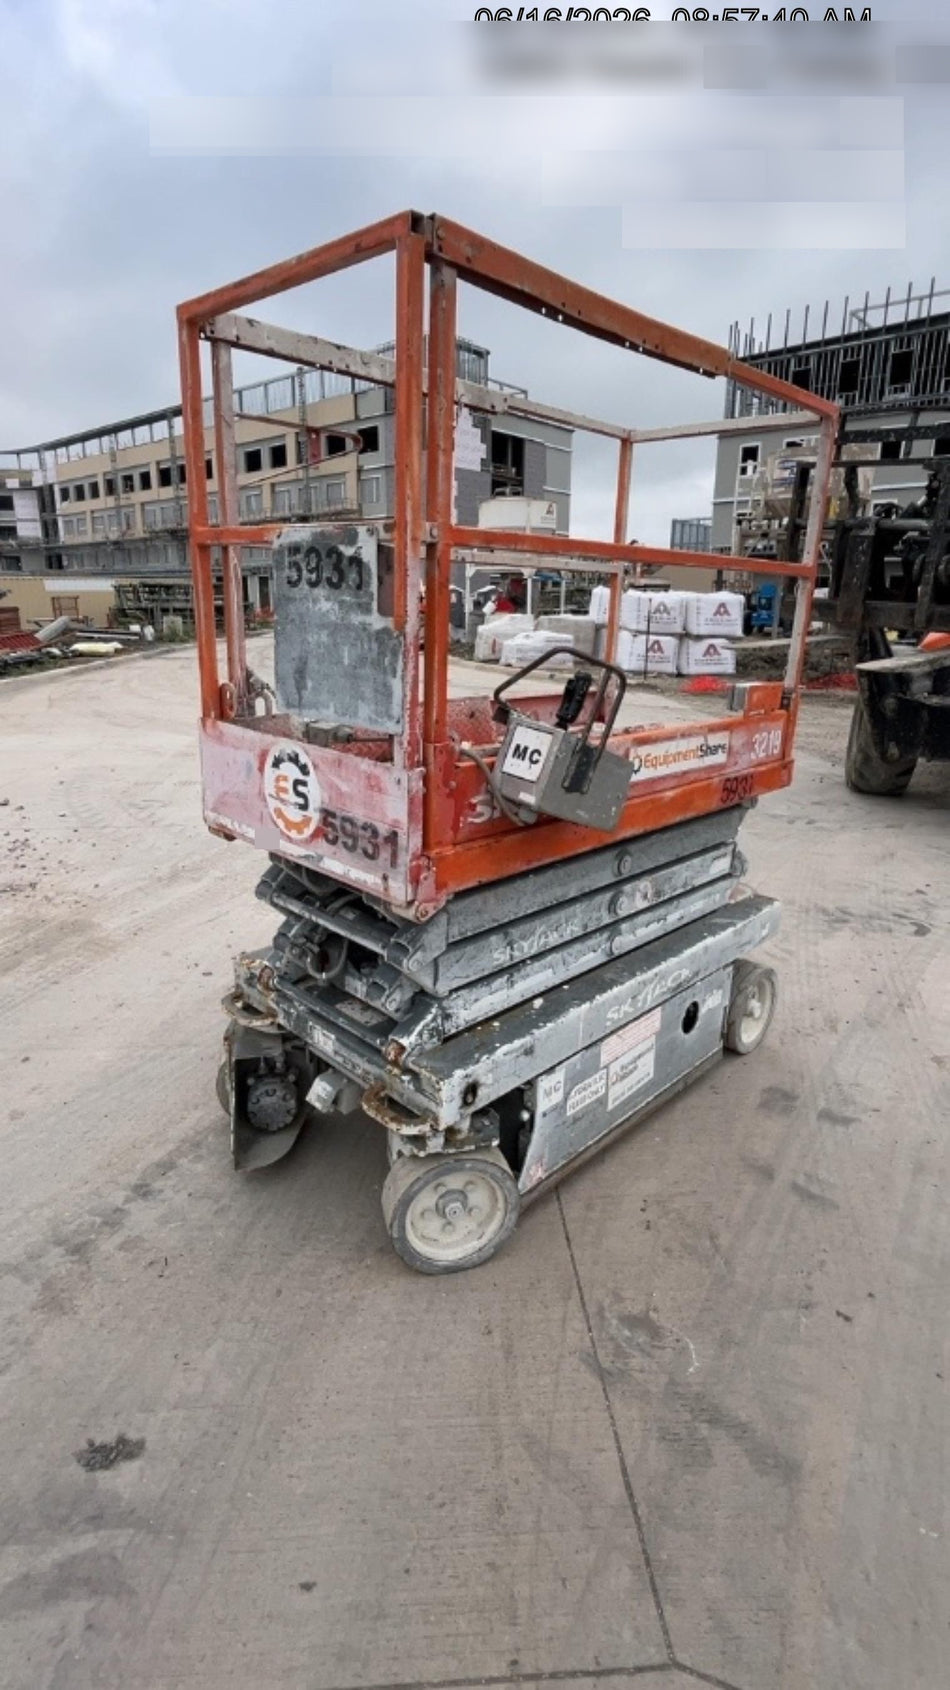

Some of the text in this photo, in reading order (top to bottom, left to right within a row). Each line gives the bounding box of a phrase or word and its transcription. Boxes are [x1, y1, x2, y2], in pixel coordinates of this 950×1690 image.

[286, 545, 363, 591] 5931
[511, 743, 542, 766] MC
[643, 742, 727, 770] EquipmentShare
[751, 730, 782, 759] 3219
[274, 774, 309, 811] ES
[320, 807, 399, 870] 5931
